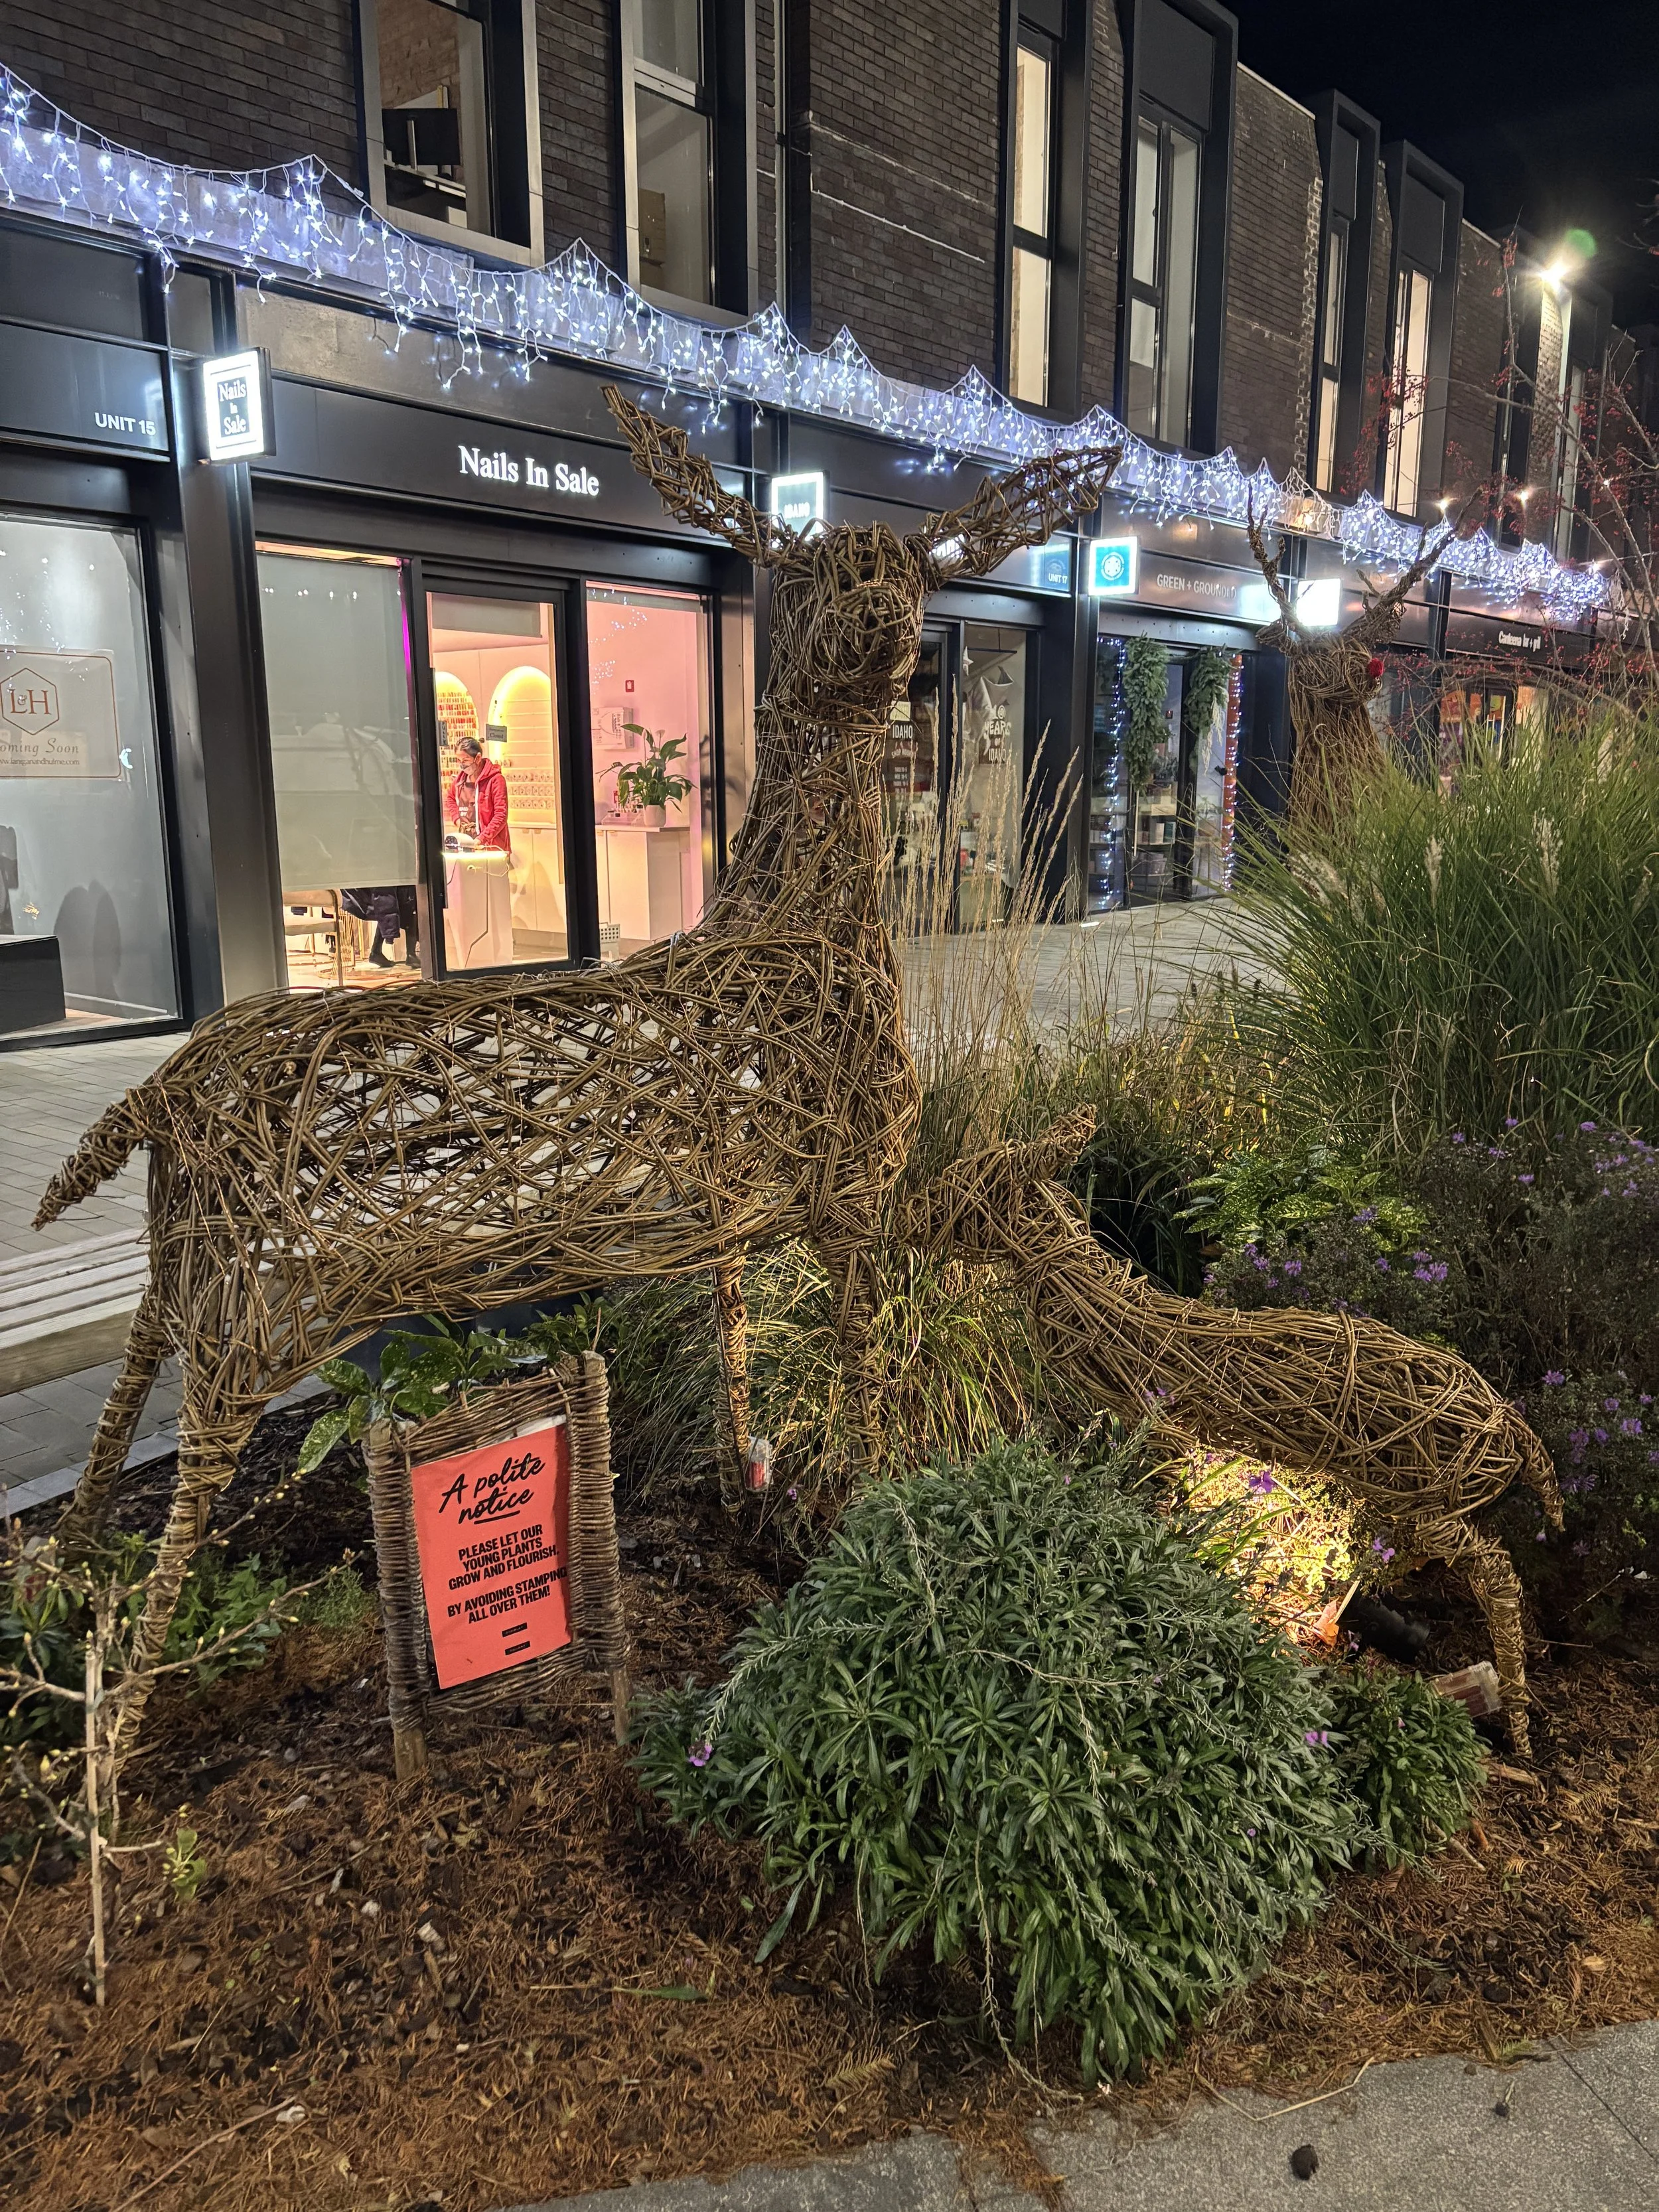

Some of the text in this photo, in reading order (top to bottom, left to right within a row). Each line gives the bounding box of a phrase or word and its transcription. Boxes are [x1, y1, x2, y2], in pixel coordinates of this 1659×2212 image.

[218, 380, 246, 402] Nails
[94, 412, 157, 436] UNIT 15
[224, 415, 246, 435] Sale
[458, 445, 600, 496] Nails In Sale
[1048, 573, 1068, 584] UNIT 17
[1157, 574, 1185, 591] GREEN
[1187, 581, 1192, 590] +
[8, 688, 52, 715] L&H
[893, 725, 913, 739] IDAHO
[983, 721, 1012, 739] YEARS
[0, 737, 79, 757] oming Soon
[439, 1452, 545, 1513] A polite
[458, 1486, 535, 1524] notice
[459, 1524, 543, 1561] PLEASE LET OUR
[463, 1537, 543, 1572] YOUNG PLANTS
[449, 1545, 559, 1590] GROW AND FLOURISH.
[447, 1566, 567, 1617] BY AVOIDING STAMPING
[469, 1585, 551, 1624] ALL OVER THEM!
